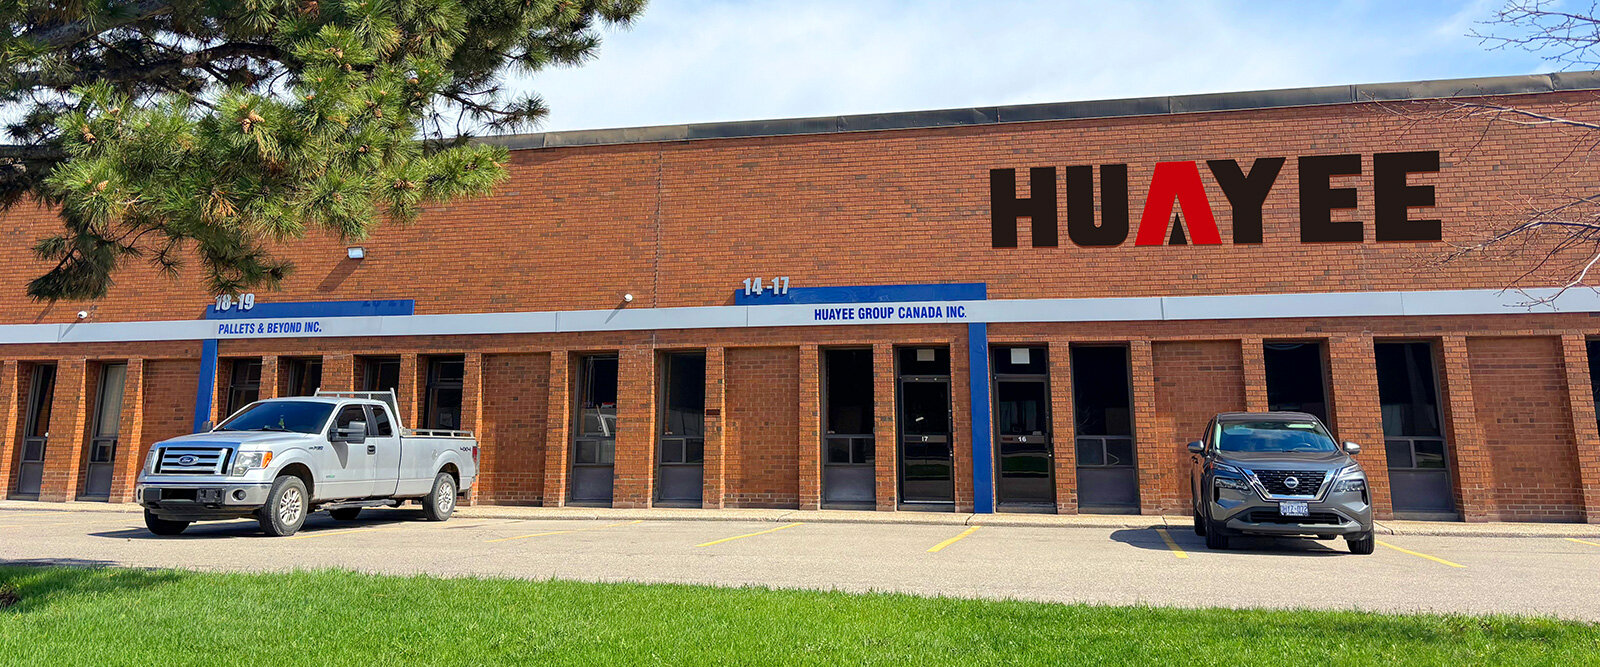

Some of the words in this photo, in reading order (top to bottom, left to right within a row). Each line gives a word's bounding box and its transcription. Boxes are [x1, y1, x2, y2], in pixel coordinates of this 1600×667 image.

[990, 151, 1442, 248] HUAYEE
[743, 276, 789, 296] 14-17
[215, 293, 255, 310] 18-19
[814, 308, 855, 321] HUAYEE
[858, 307, 894, 319] GROUP
[898, 306, 943, 319] CANADA
[946, 305, 967, 318] INC.
[218, 323, 255, 334] PALLETS
[257, 322, 265, 334] &
[267, 322, 302, 333] BEYOND
[304, 321, 322, 333] INC.
